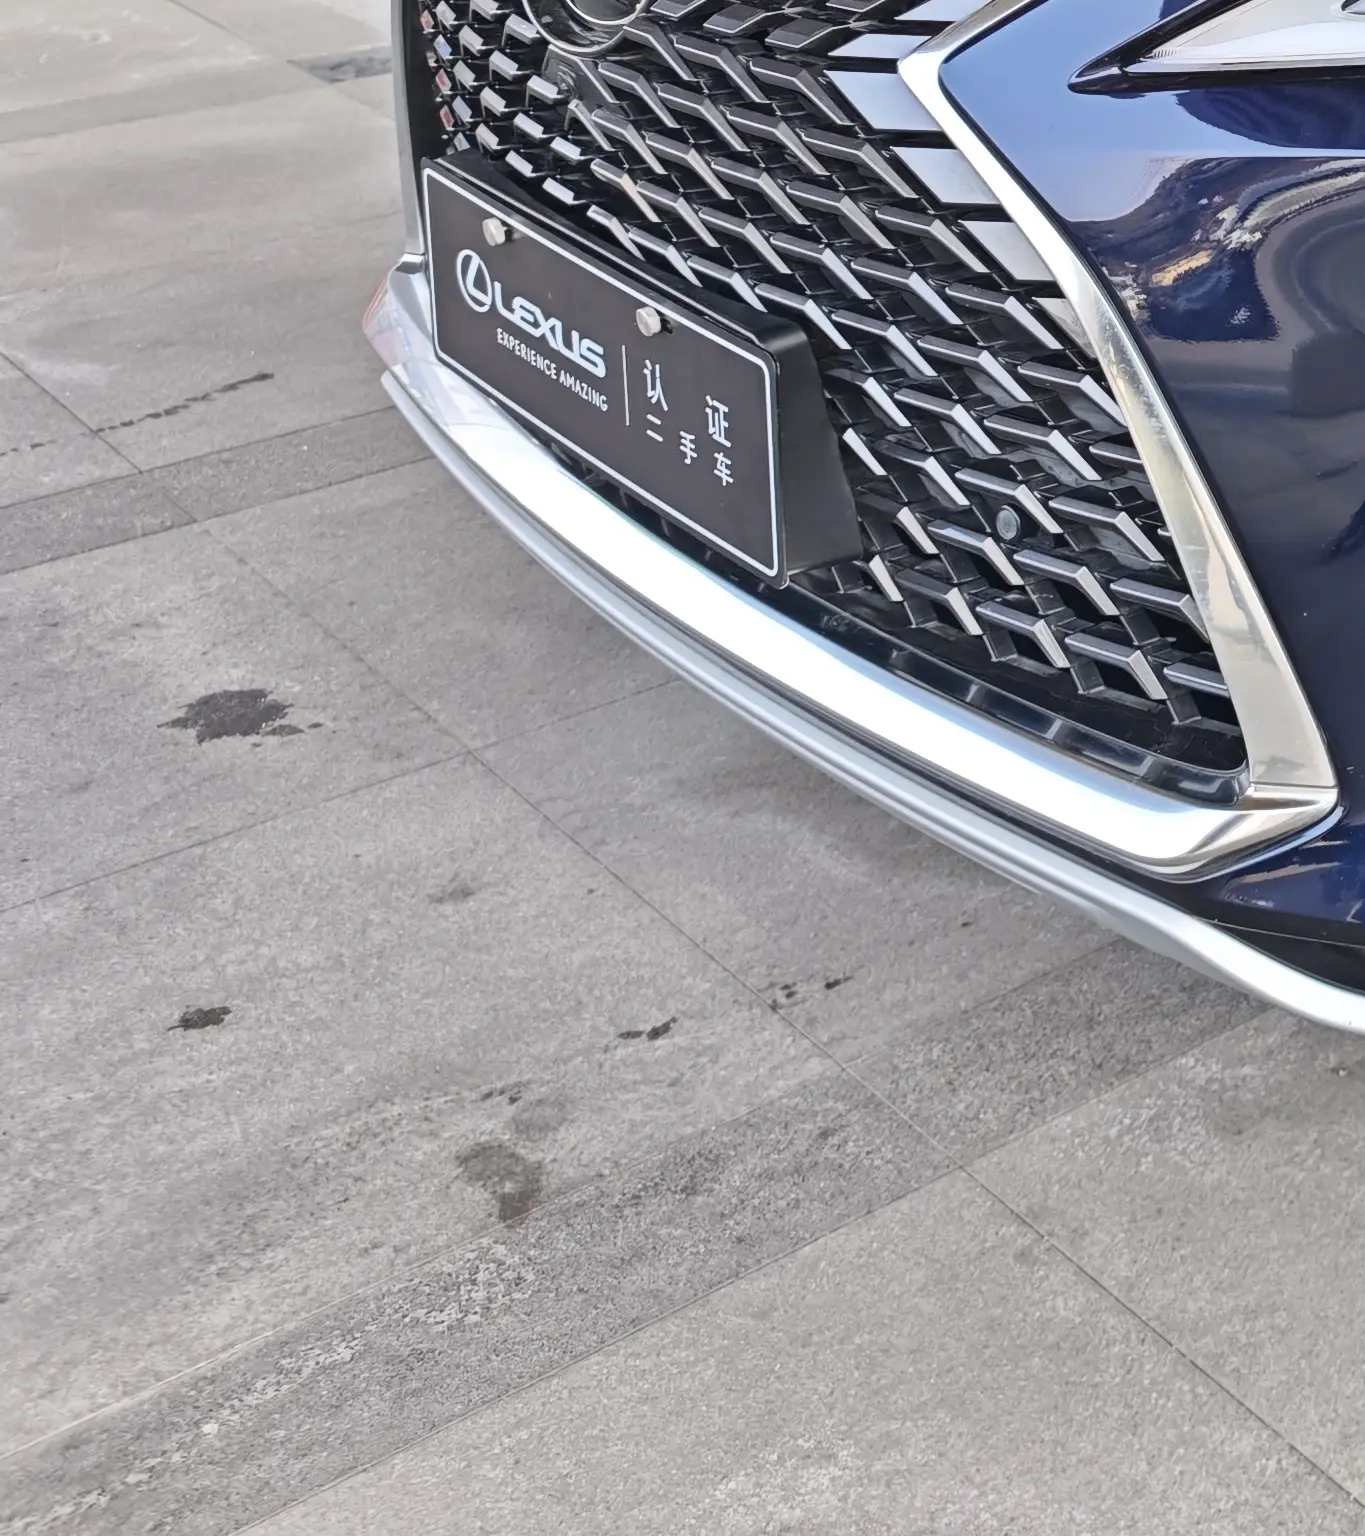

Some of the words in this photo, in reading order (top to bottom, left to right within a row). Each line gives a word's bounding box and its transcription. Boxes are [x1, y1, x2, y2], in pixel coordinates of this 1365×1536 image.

[494, 281, 606, 378] LEXUS
[496, 327, 557, 381] EXPERIENCE
[559, 367, 608, 413] AMAZING
[642, 358, 732, 448] 认证
[646, 413, 734, 486] 二手车
